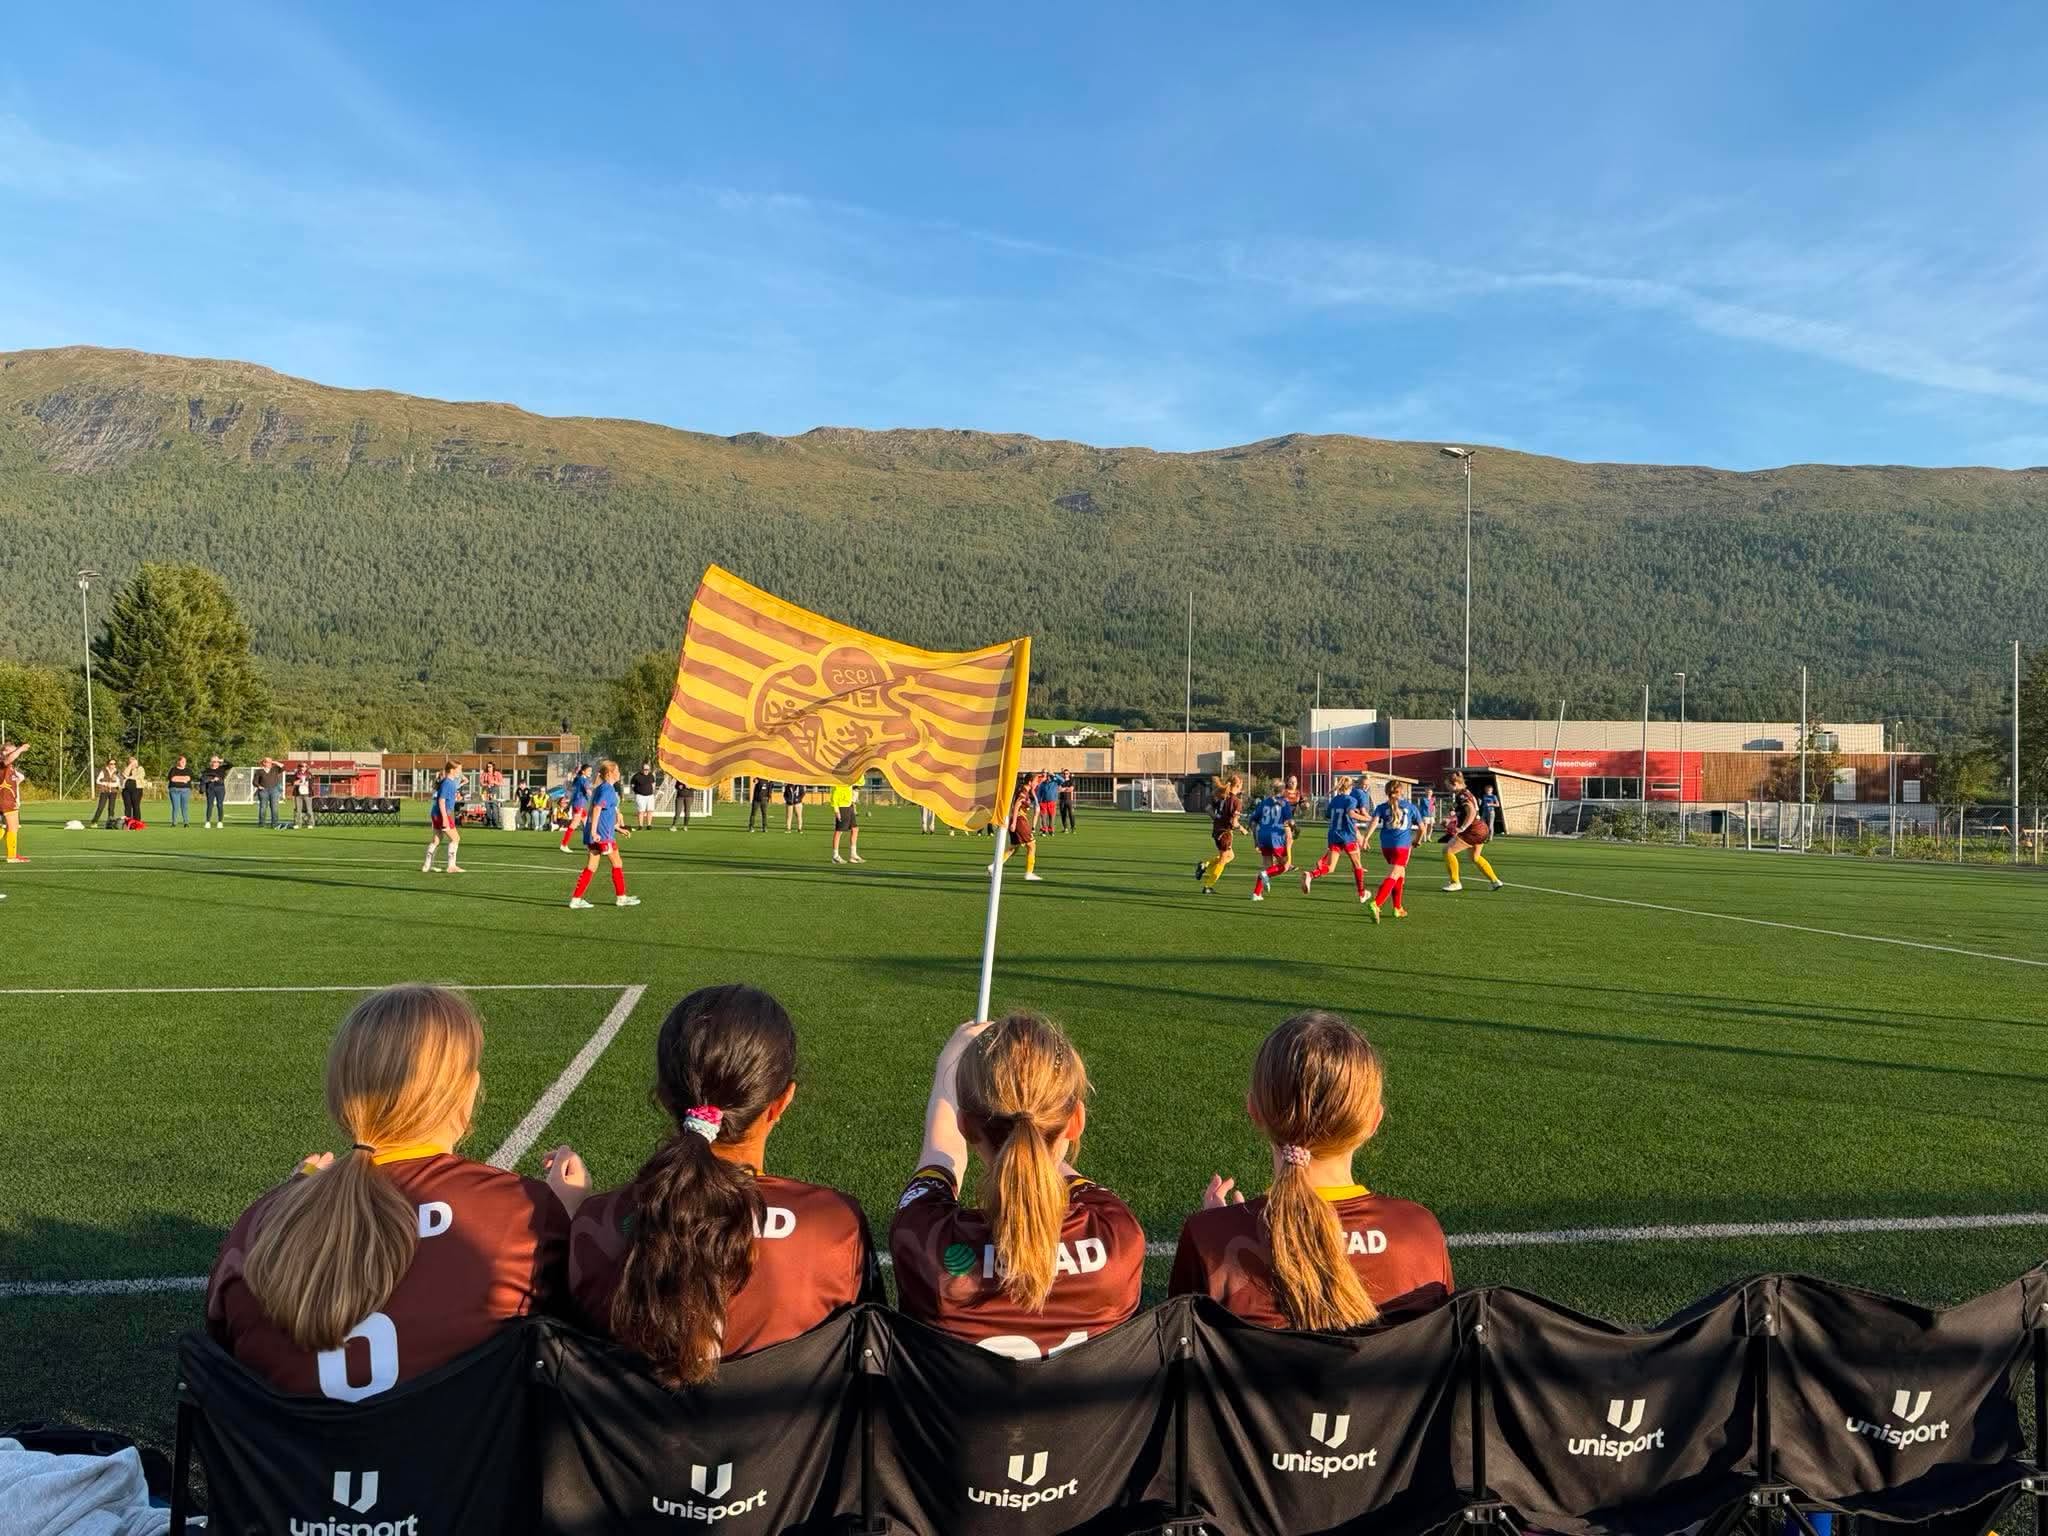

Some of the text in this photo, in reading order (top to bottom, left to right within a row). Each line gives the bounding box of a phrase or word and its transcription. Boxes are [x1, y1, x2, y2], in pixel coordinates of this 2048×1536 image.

[983, 1237, 1108, 1278] IAD
[1568, 1427, 1664, 1462] unisport
[1846, 1415, 1949, 1450] unisport
[1272, 1447, 1377, 1478] unisport
[652, 1488, 767, 1524] unisport
[967, 1478, 1078, 1512] unisport
[289, 1514, 418, 1536] unisport
